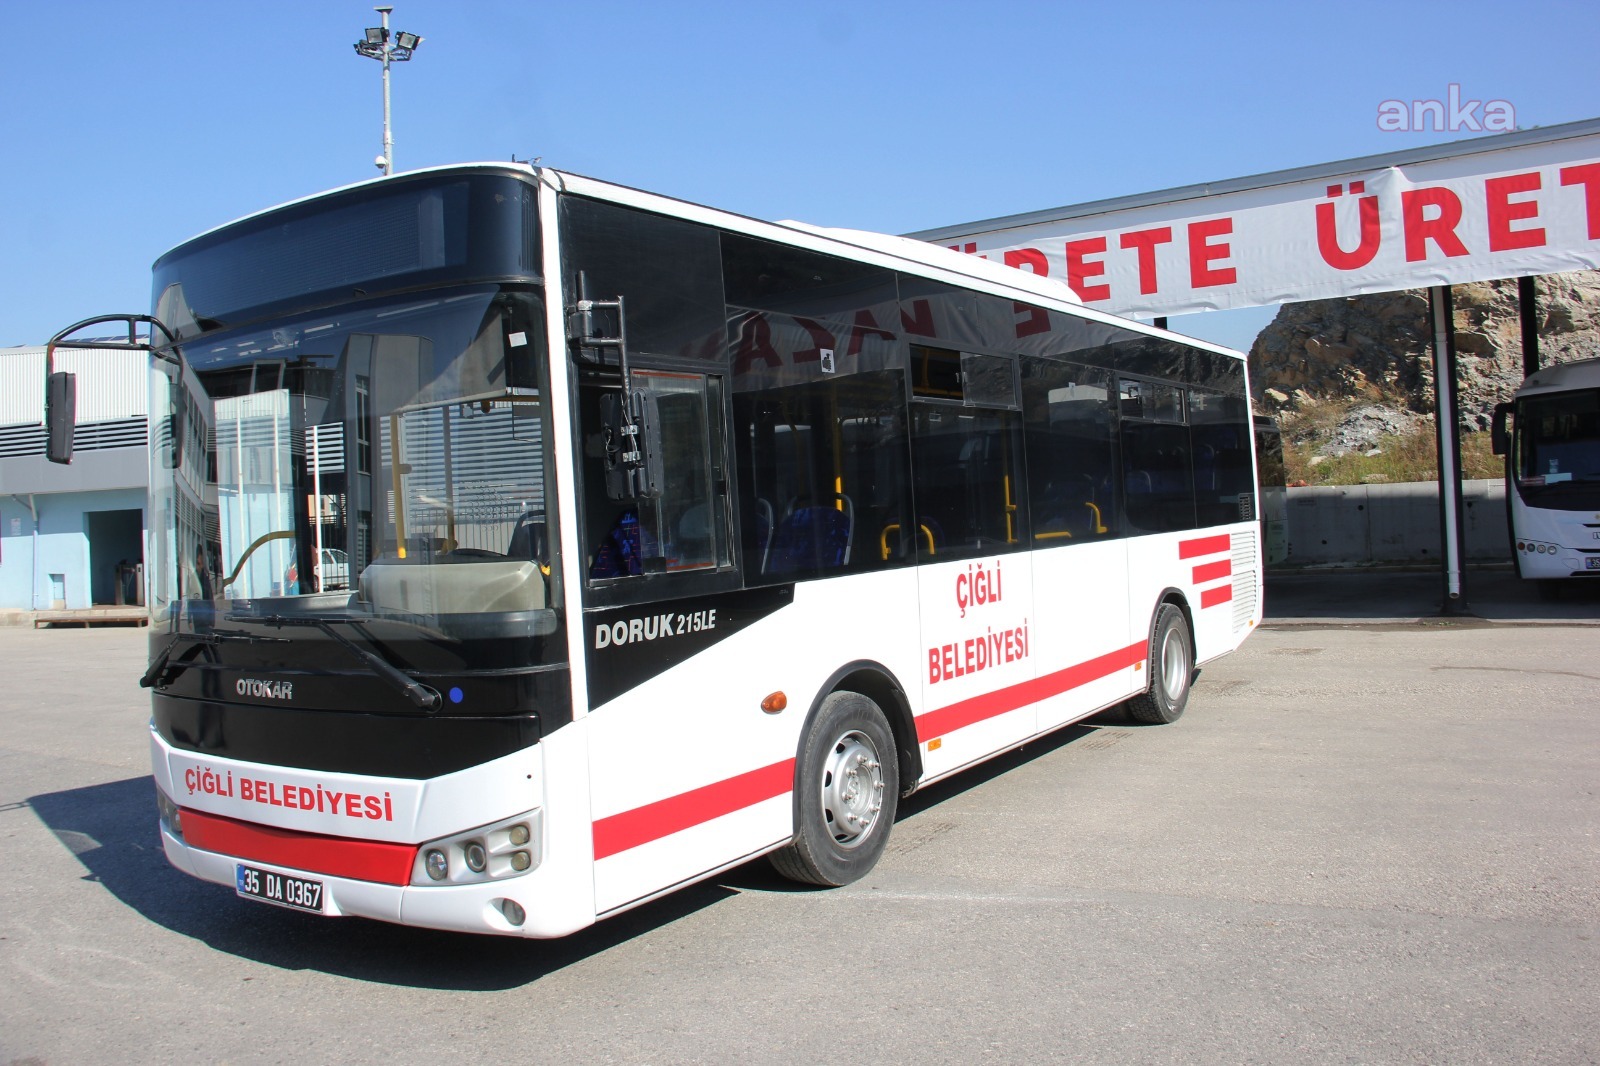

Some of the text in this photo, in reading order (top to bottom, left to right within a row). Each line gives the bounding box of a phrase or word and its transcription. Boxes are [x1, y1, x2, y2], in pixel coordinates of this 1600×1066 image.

[947, 217, 1237, 302] ETE
[956, 560, 1003, 618] ÇİĞLİ
[595, 609, 717, 649] DORUK 215LE
[928, 618, 1029, 685] BELEDİYESİ
[236, 679, 293, 700] OTOKAR
[184, 765, 393, 822] ÇİĞLİ BELEDİYESİ
[244, 869, 322, 908] 35 DA 0367
